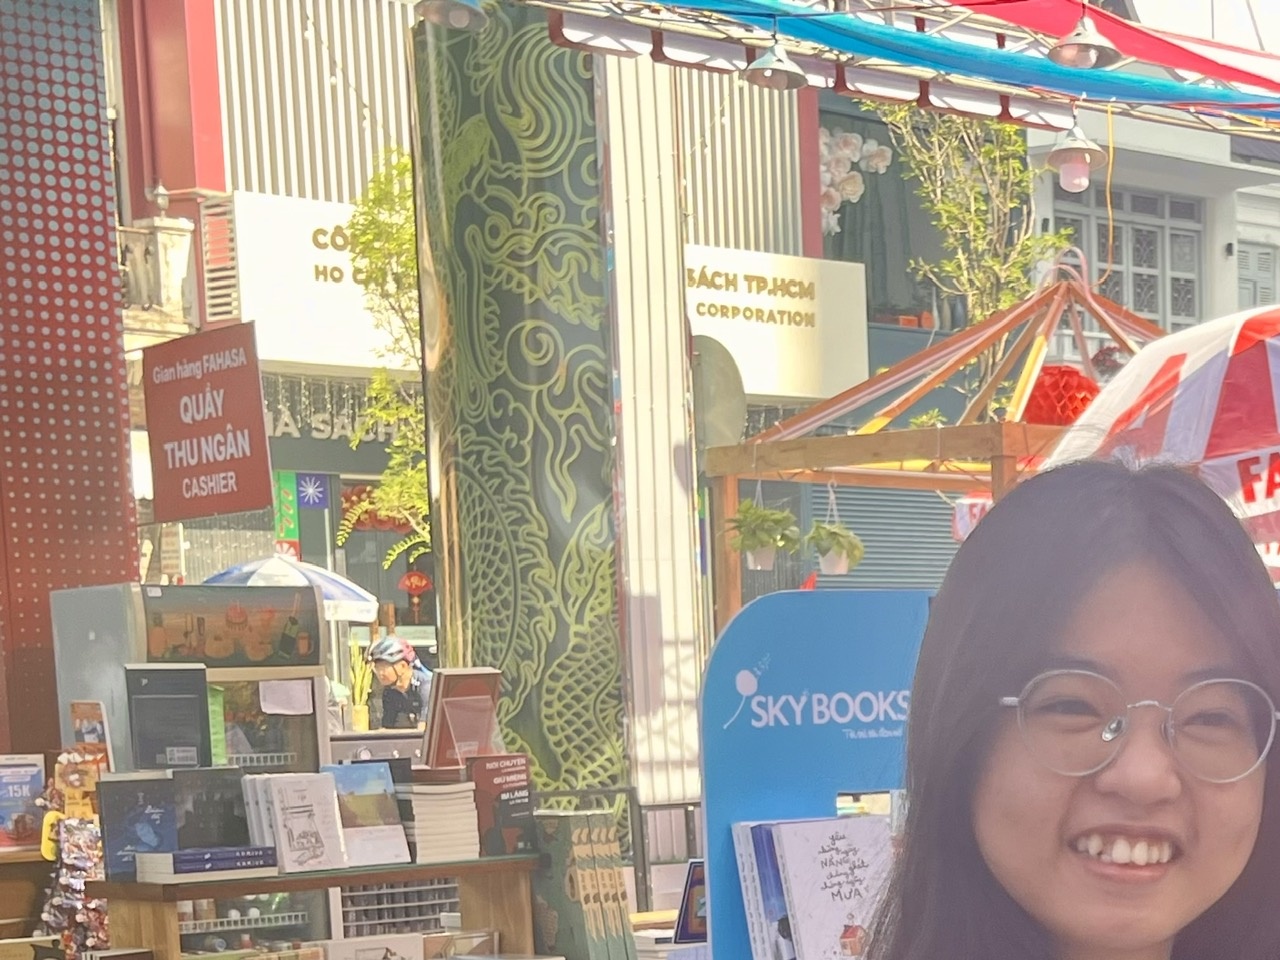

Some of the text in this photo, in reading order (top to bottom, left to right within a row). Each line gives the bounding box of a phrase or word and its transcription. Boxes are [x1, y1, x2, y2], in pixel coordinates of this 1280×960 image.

[696, 302, 816, 328] CORPORATION
[153, 347, 247, 384] Gian hàng FAHASA
[164, 423, 251, 469] THU NGÂN
[183, 471, 238, 498] CASHIER
[751, 691, 910, 728] SKY BOOKS
[8, 784, 31, 797] 15K
